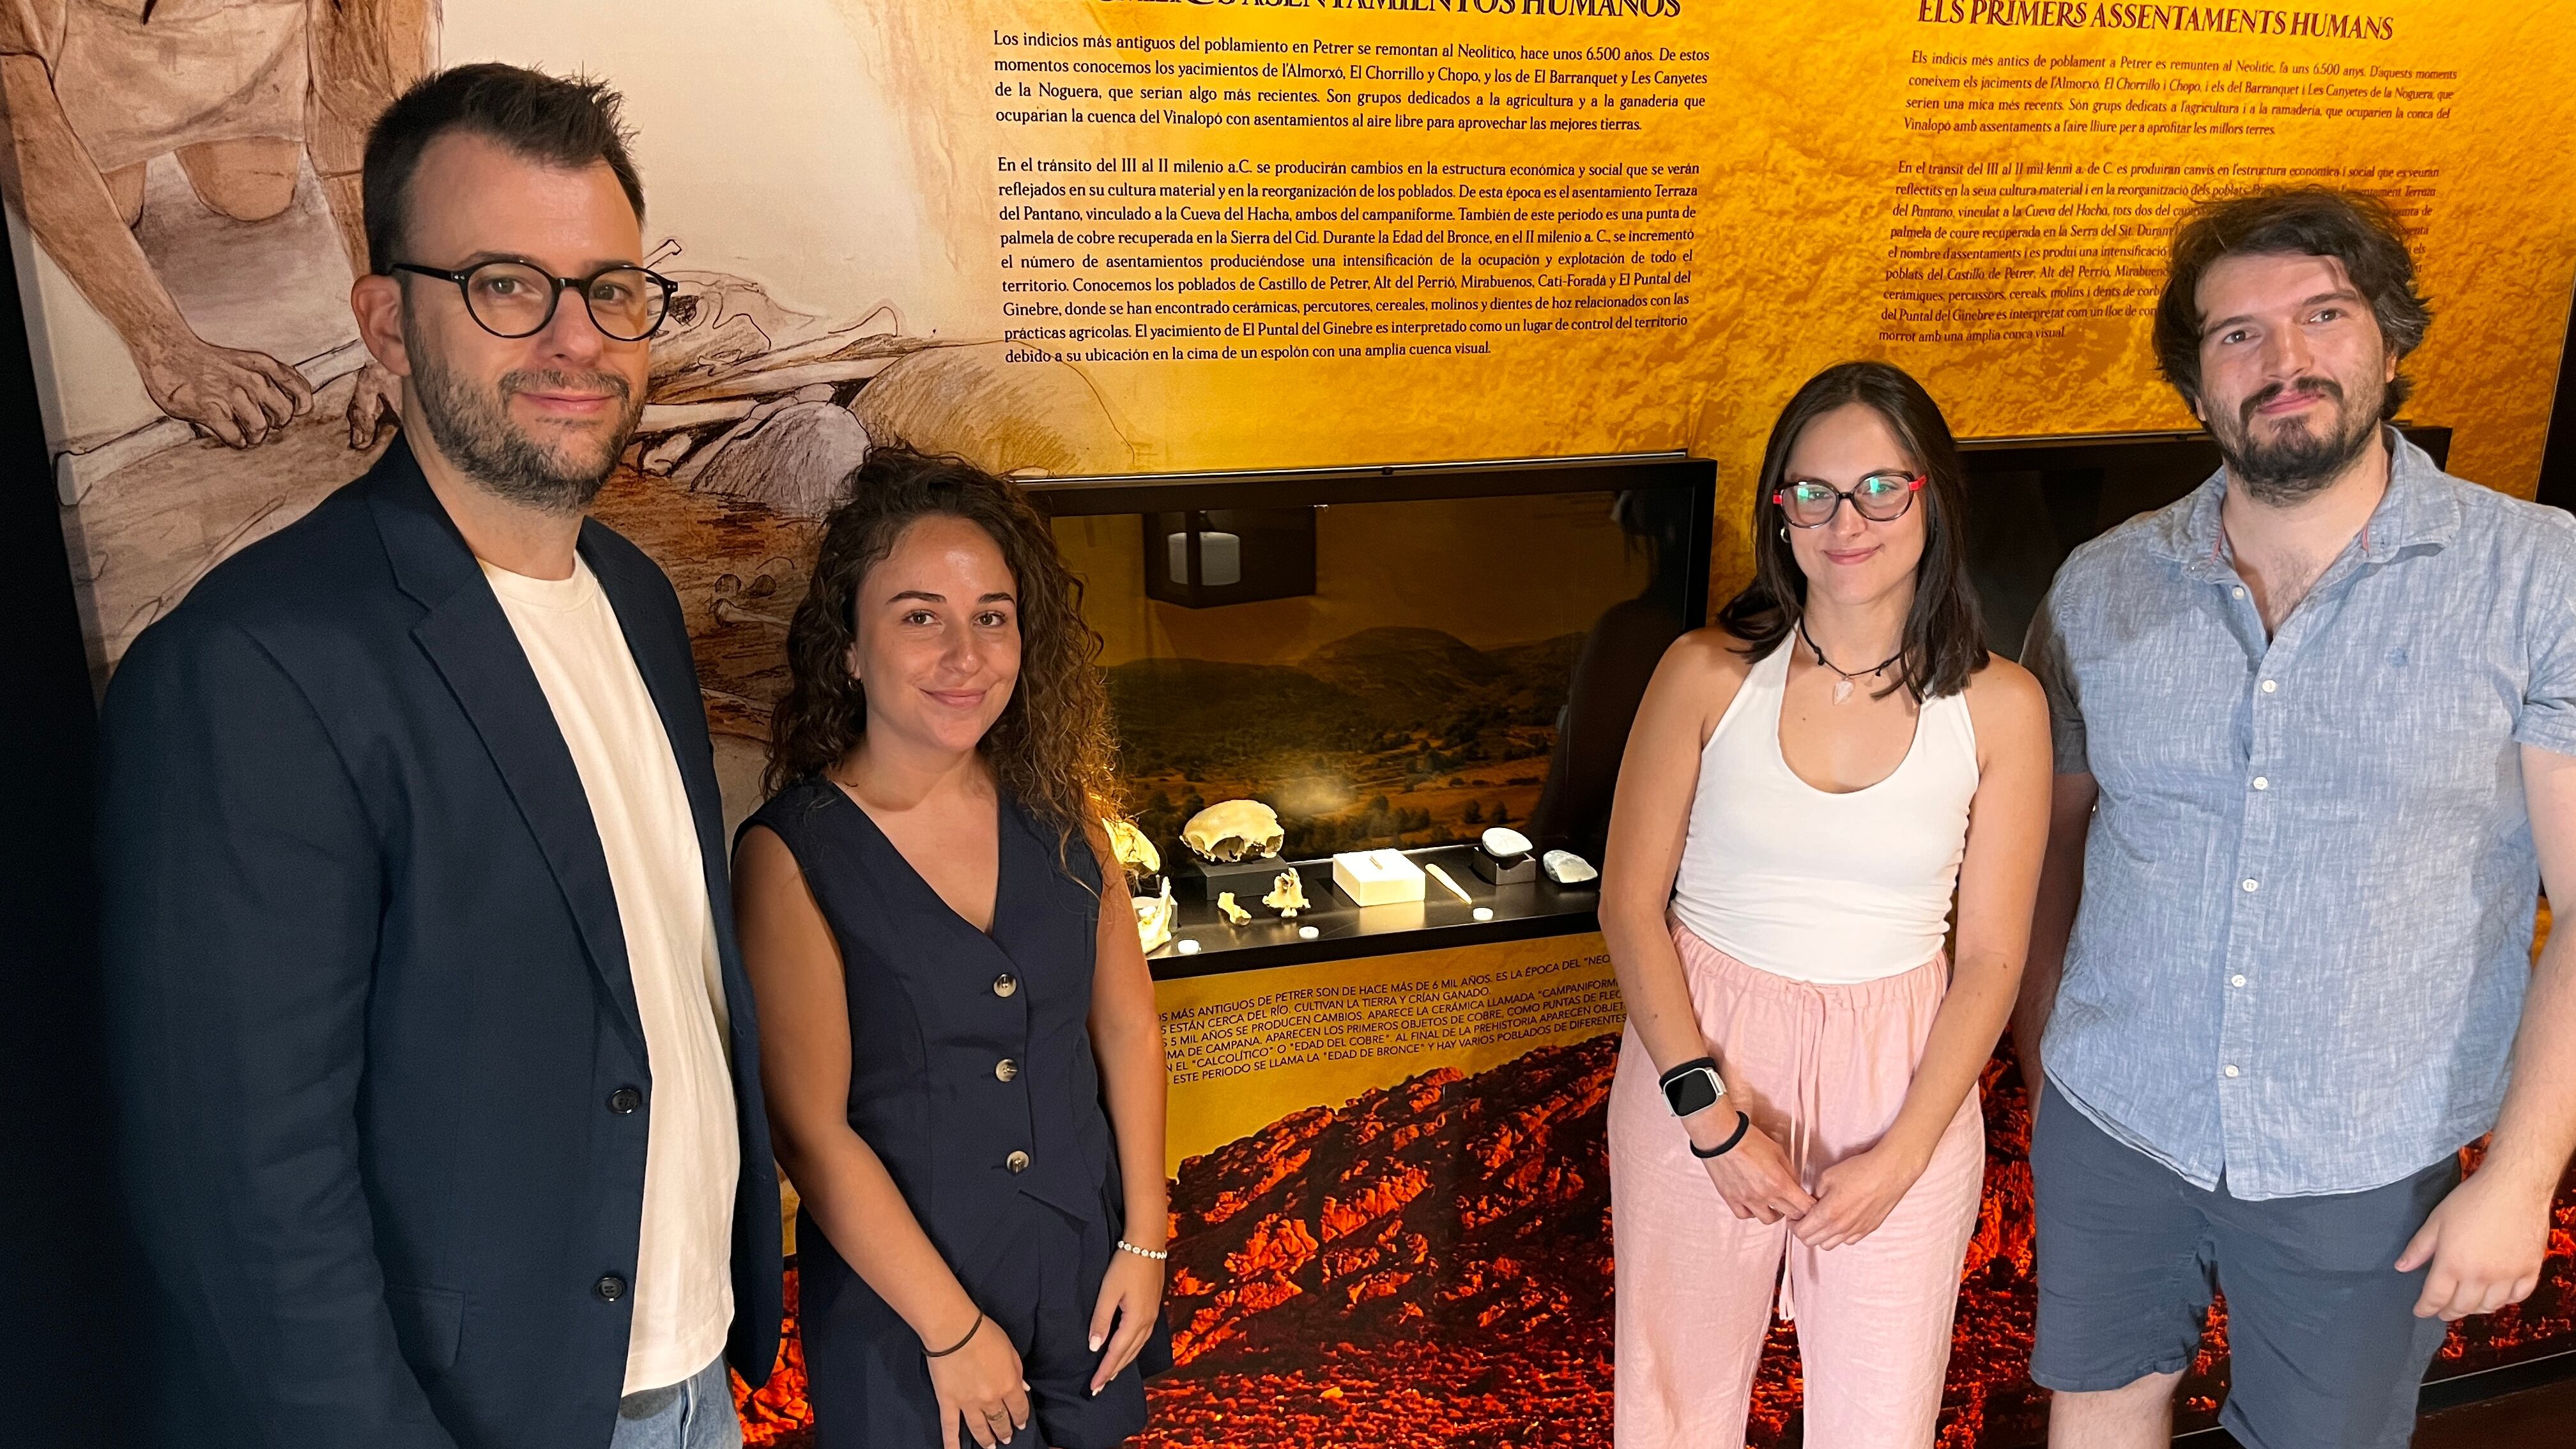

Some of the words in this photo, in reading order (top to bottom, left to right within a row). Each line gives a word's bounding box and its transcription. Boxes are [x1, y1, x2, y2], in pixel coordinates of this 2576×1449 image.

[1917, 0, 1965, 24] ELS
[1970, 0, 2087, 27] PRIMERS
[2090, 2, 2286, 34] ASSENTAMENTS
[2290, 12, 2393, 40] HUMANS
[994, 29, 1018, 45] Los
[1023, 31, 1078, 47] indicios
[1083, 34, 1112, 48] más
[1116, 35, 1176, 53] antiguos
[1179, 35, 1200, 50] del
[1204, 36, 1288, 54] poblamiento
[1292, 43, 1308, 54] en
[1313, 39, 1354, 54] Petrer
[1357, 45, 1371, 55] se
[1376, 45, 1438, 57] remontan
[1442, 43, 1453, 57] al
[1458, 43, 1516, 60] Neolítico,
[1520, 45, 1549, 60] hace
[1553, 50, 1583, 61] unos
[1586, 47, 1621, 61] 6.500
[1624, 49, 1655, 61] años.
[1659, 47, 1676, 61] De
[1680, 50, 1710, 61] estos
[994, 60, 1069, 72] momentos
[1073, 63, 1151, 74] conocemos
[1155, 59, 1175, 75] los
[1177, 62, 1259, 78] yacimientos
[1262, 63, 1278, 77] de
[1282, 62, 1346, 80] l'Almorxó,
[1350, 65, 1361, 79] El
[1365, 65, 1424, 80] Chorrillo
[1427, 71, 1435, 84] y
[1438, 66, 1481, 85] Chopo,
[1483, 73, 1491, 85] y
[1494, 68, 1512, 82] los
[1515, 69, 1530, 83] de
[1534, 69, 1545, 84] El
[1549, 69, 1618, 88] Barranquet
[1620, 75, 1628, 88] y
[1631, 70, 1651, 84] Les
[1654, 70, 1707, 87] Canyetes
[1943, 100, 1965, 110] una
[1968, 98, 1995, 111] mica
[2092, 102, 2122, 114] grups
[2125, 98, 2167, 112] dedicats
[2170, 103, 2177, 113] a
[2242, 102, 2246, 114] i
[2249, 105, 2255, 114] a
[2258, 102, 2268, 114] la
[2325, 108, 2343, 119] que
[2346, 109, 2393, 120] ocuparien
[2395, 107, 2404, 119] la
[2407, 111, 2434, 119] conca
[2436, 107, 2451, 119] del
[1953, 119, 1977, 132] amb
[1979, 122, 2052, 132] assentaments
[2053, 123, 2060, 132] a
[2119, 124, 2137, 135] per
[2138, 123, 2145, 133] a
[2147, 121, 2192, 136] aprofitar
[2193, 121, 2207, 134] les
[2209, 122, 2244, 135] millors
[997, 157, 1016, 172] En
[1020, 157, 1033, 172] el
[1037, 158, 1092, 172] tránsito
[1096, 157, 1117, 172] del
[1122, 157, 1137, 172] III
[1142, 158, 1154, 172] al
[1158, 158, 1168, 172] II
[1174, 158, 1223, 173] milenio
[1227, 159, 1252, 173] a.C.
[1257, 164, 1271, 174] se
[1275, 160, 1347, 177] producirán
[1351, 160, 1404, 174] cambios
[1407, 165, 1423, 174] en
[1427, 160, 1438, 174] la
[1442, 164, 1506, 176] estructura
[1510, 164, 1575, 176] económica
[1578, 167, 1586, 178] y
[1588, 162, 1623, 176] social
[1626, 166, 1648, 179] que
[1651, 166, 1664, 176] se
[1667, 163, 1699, 175] verán
[1005, 348, 1051, 363] debido
[1054, 352, 1064, 362] a
[1066, 351, 1082, 362] su
[1085, 348, 1149, 362] ubicación
[1153, 351, 1169, 360] en
[1172, 346, 1184, 360] la
[1186, 347, 1218, 360] cima
[1222, 346, 1238, 359] de
[1241, 349, 1257, 358] un
[1261, 344, 1309, 361] espolón
[1312, 348, 1335, 358] con
[1338, 348, 1361, 357] una
[1365, 342, 1406, 359] amplia
[1409, 345, 1452, 355] cuenca
[1454, 341, 1491, 354] visual.
[1171, 1008, 1195, 1021] MÁS
[1197, 998, 1255, 1017] ANTIGUOS
[1257, 995, 1273, 1007] DE
[1275, 988, 1314, 1003] PETRER
[1315, 986, 1339, 997] SON
[1342, 986, 1356, 996] DE
[1359, 984, 1388, 995] HACE
[1391, 981, 1413, 993] MÁS
[1416, 981, 1430, 991] DE
[1432, 980, 1439, 990] 6
[1441, 979, 1458, 989] MIL
[1460, 974, 1492, 987] AÑOS.
[1496, 971, 1508, 981] ES
[1510, 969, 1523, 979] LA
[1525, 963, 1560, 977] ÉPOCA
[1562, 958, 1581, 970] DEL
[1170, 1019, 1205, 1034] ESTÁN
[1208, 1013, 1245, 1028] CERCA
[1247, 1009, 1268, 1022] DEL
[1270, 1004, 1291, 1017] RÍO.
[1294, 999, 1344, 1013] CULTIVAN
[1347, 999, 1360, 1009] LA
[1361, 996, 1397, 1008] TIERRA
[1399, 995, 1406, 1004] Y
[1408, 992, 1440, 1004] CRÍAN
[1443, 986, 1491, 1001] GANADO.
[1173, 1071, 1199, 1084] ESTE
[1202, 1063, 1251, 1080] PERIODO
[1254, 1060, 1266, 1071] SE
[1269, 1054, 1305, 1068] LLAMA
[1307, 1053, 1320, 1062] LA
[1323, 1049, 1358, 1061] "EDAD
[1360, 1048, 1374, 1058] DE
[1377, 1043, 1425, 1056] BRONCE"
[1427, 1042, 1435, 1051] Y
[1437, 1039, 1457, 1050] HAY
[1459, 1034, 1495, 1048] VARIOS
[1497, 1025, 1551, 1042] POBLADOS
[1554, 1022, 1567, 1032] DE
[1569, 1015, 1627, 1030] DIFERENTES
